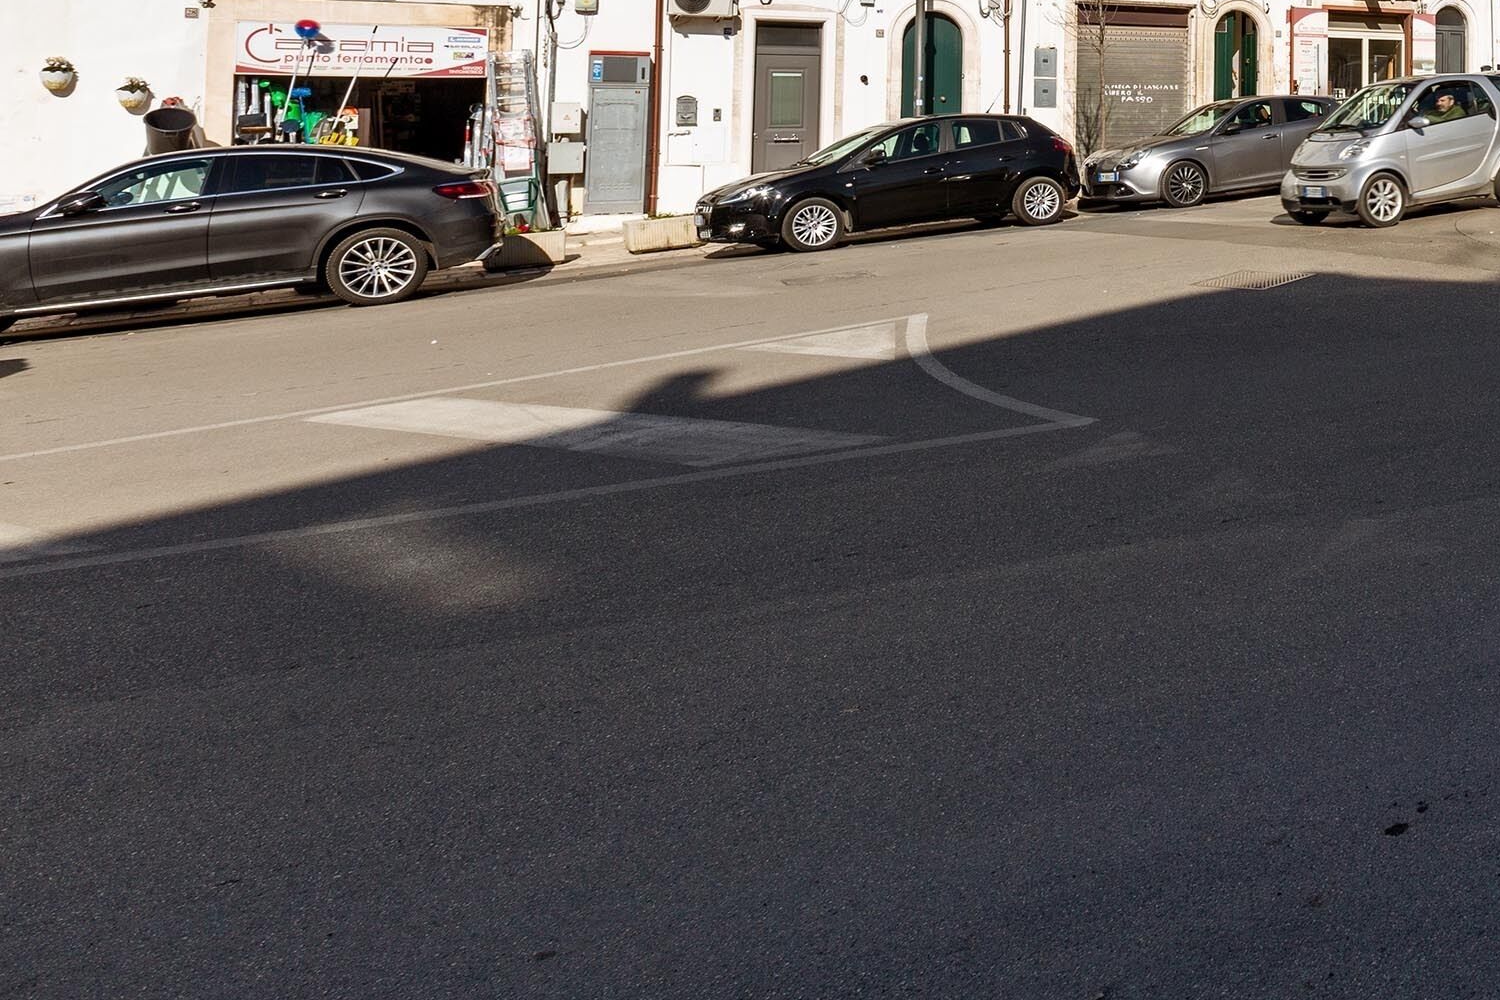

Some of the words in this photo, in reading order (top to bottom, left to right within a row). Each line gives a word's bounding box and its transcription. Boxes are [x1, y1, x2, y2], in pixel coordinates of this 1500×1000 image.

[285, 53, 331, 63] punto
[338, 53, 424, 64] ferramenta
[1121, 96, 1153, 104] PASSO
